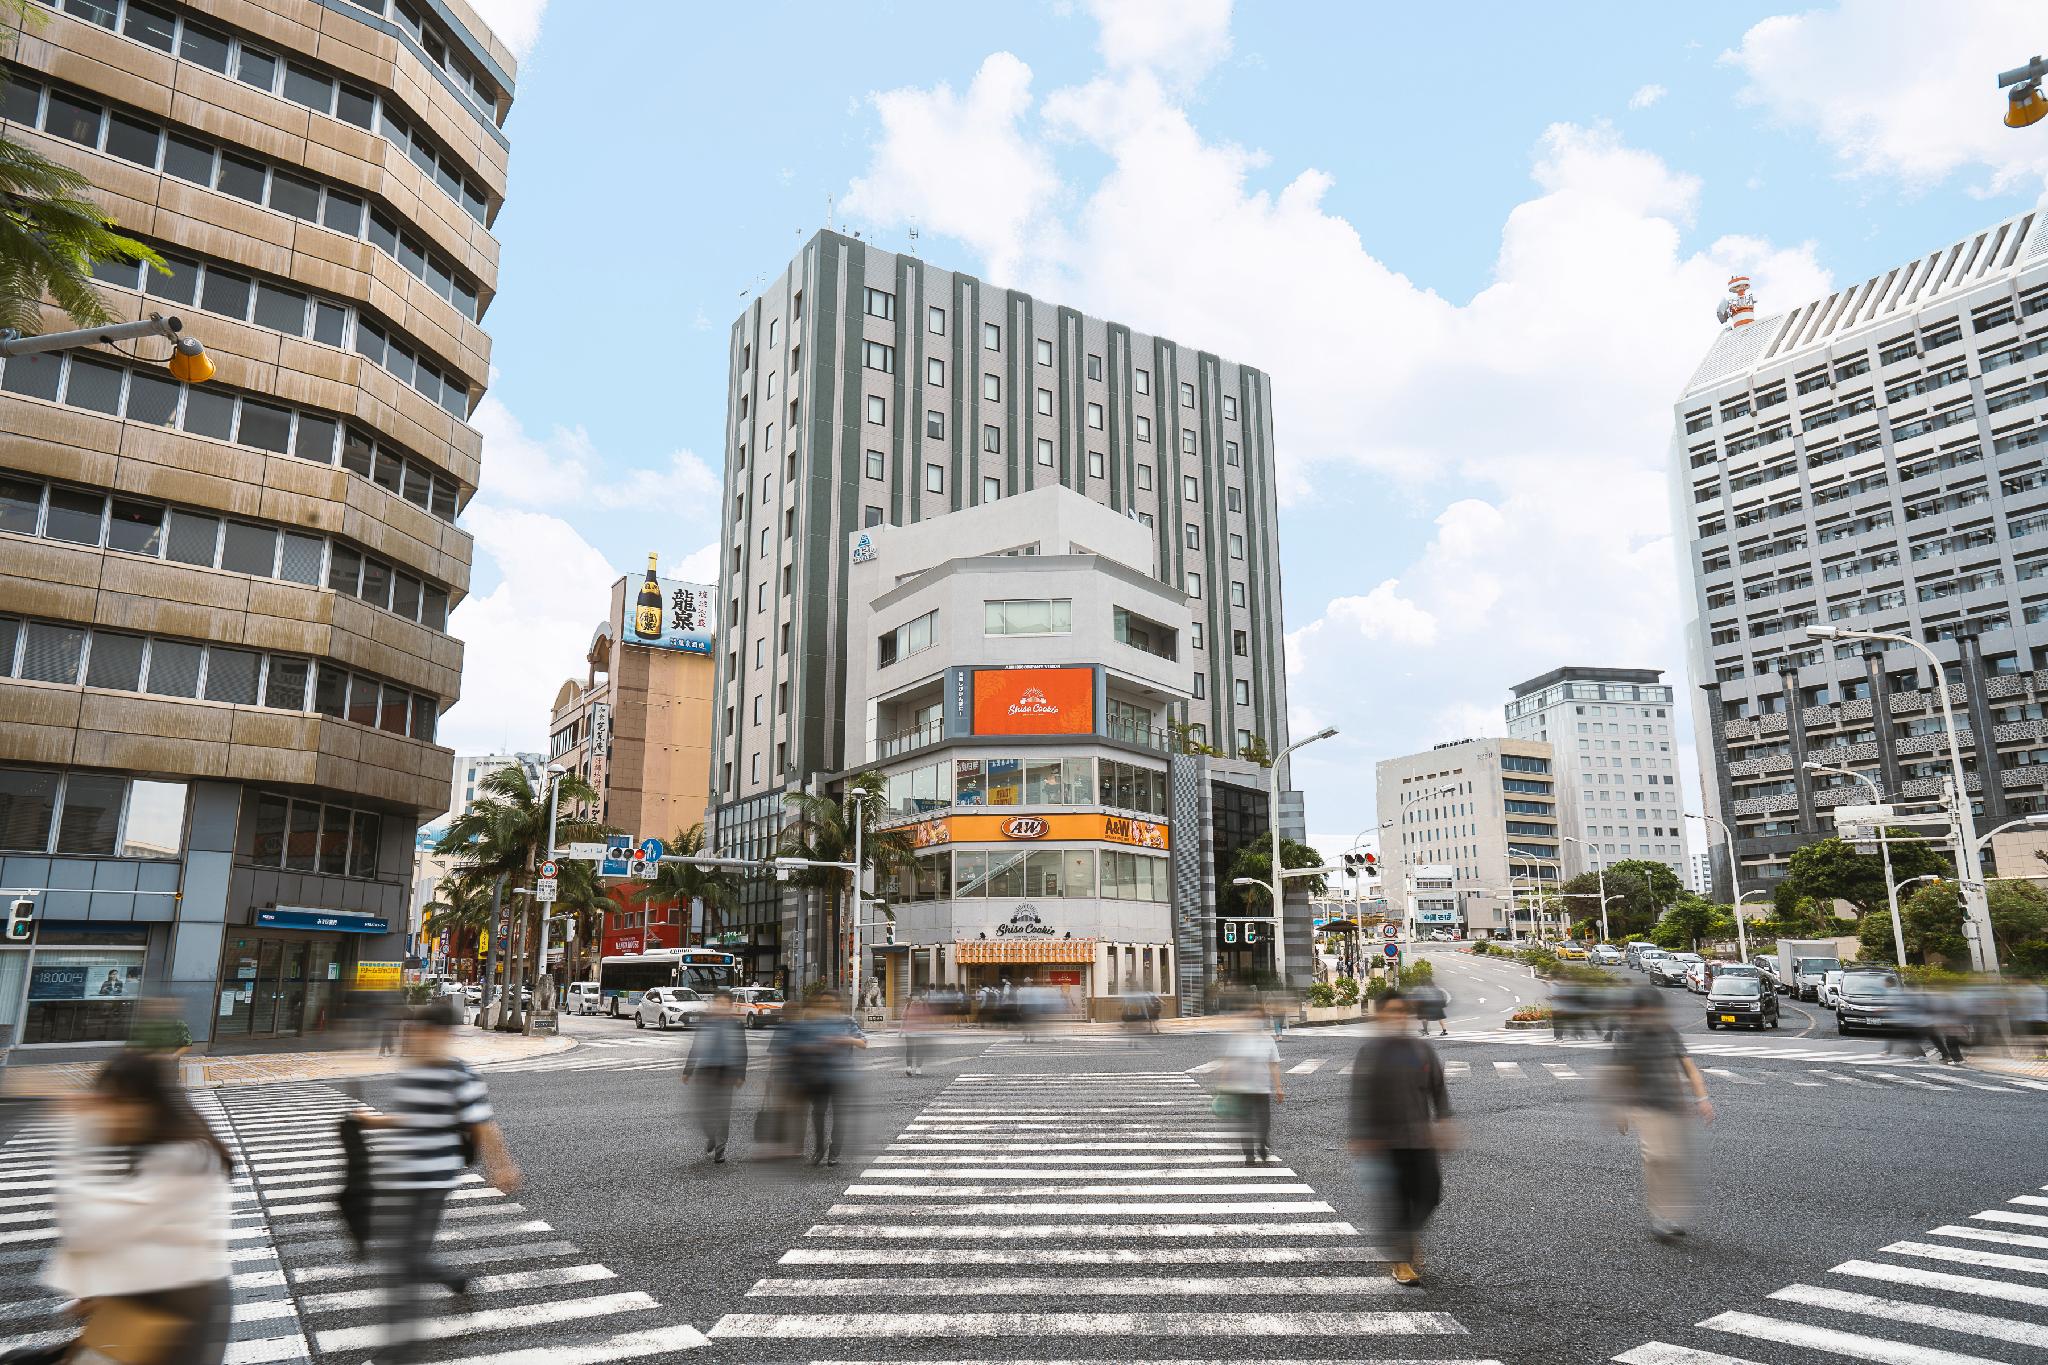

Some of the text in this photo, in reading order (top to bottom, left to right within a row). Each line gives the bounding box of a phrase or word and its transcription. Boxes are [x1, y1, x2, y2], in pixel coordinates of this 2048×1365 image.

[672, 588, 696, 631] 龍泉
[1008, 703, 1058, 716] Shisa Cookie
[1105, 817, 1130, 837] A&W
[996, 923, 1055, 936] Shisa Cookie
